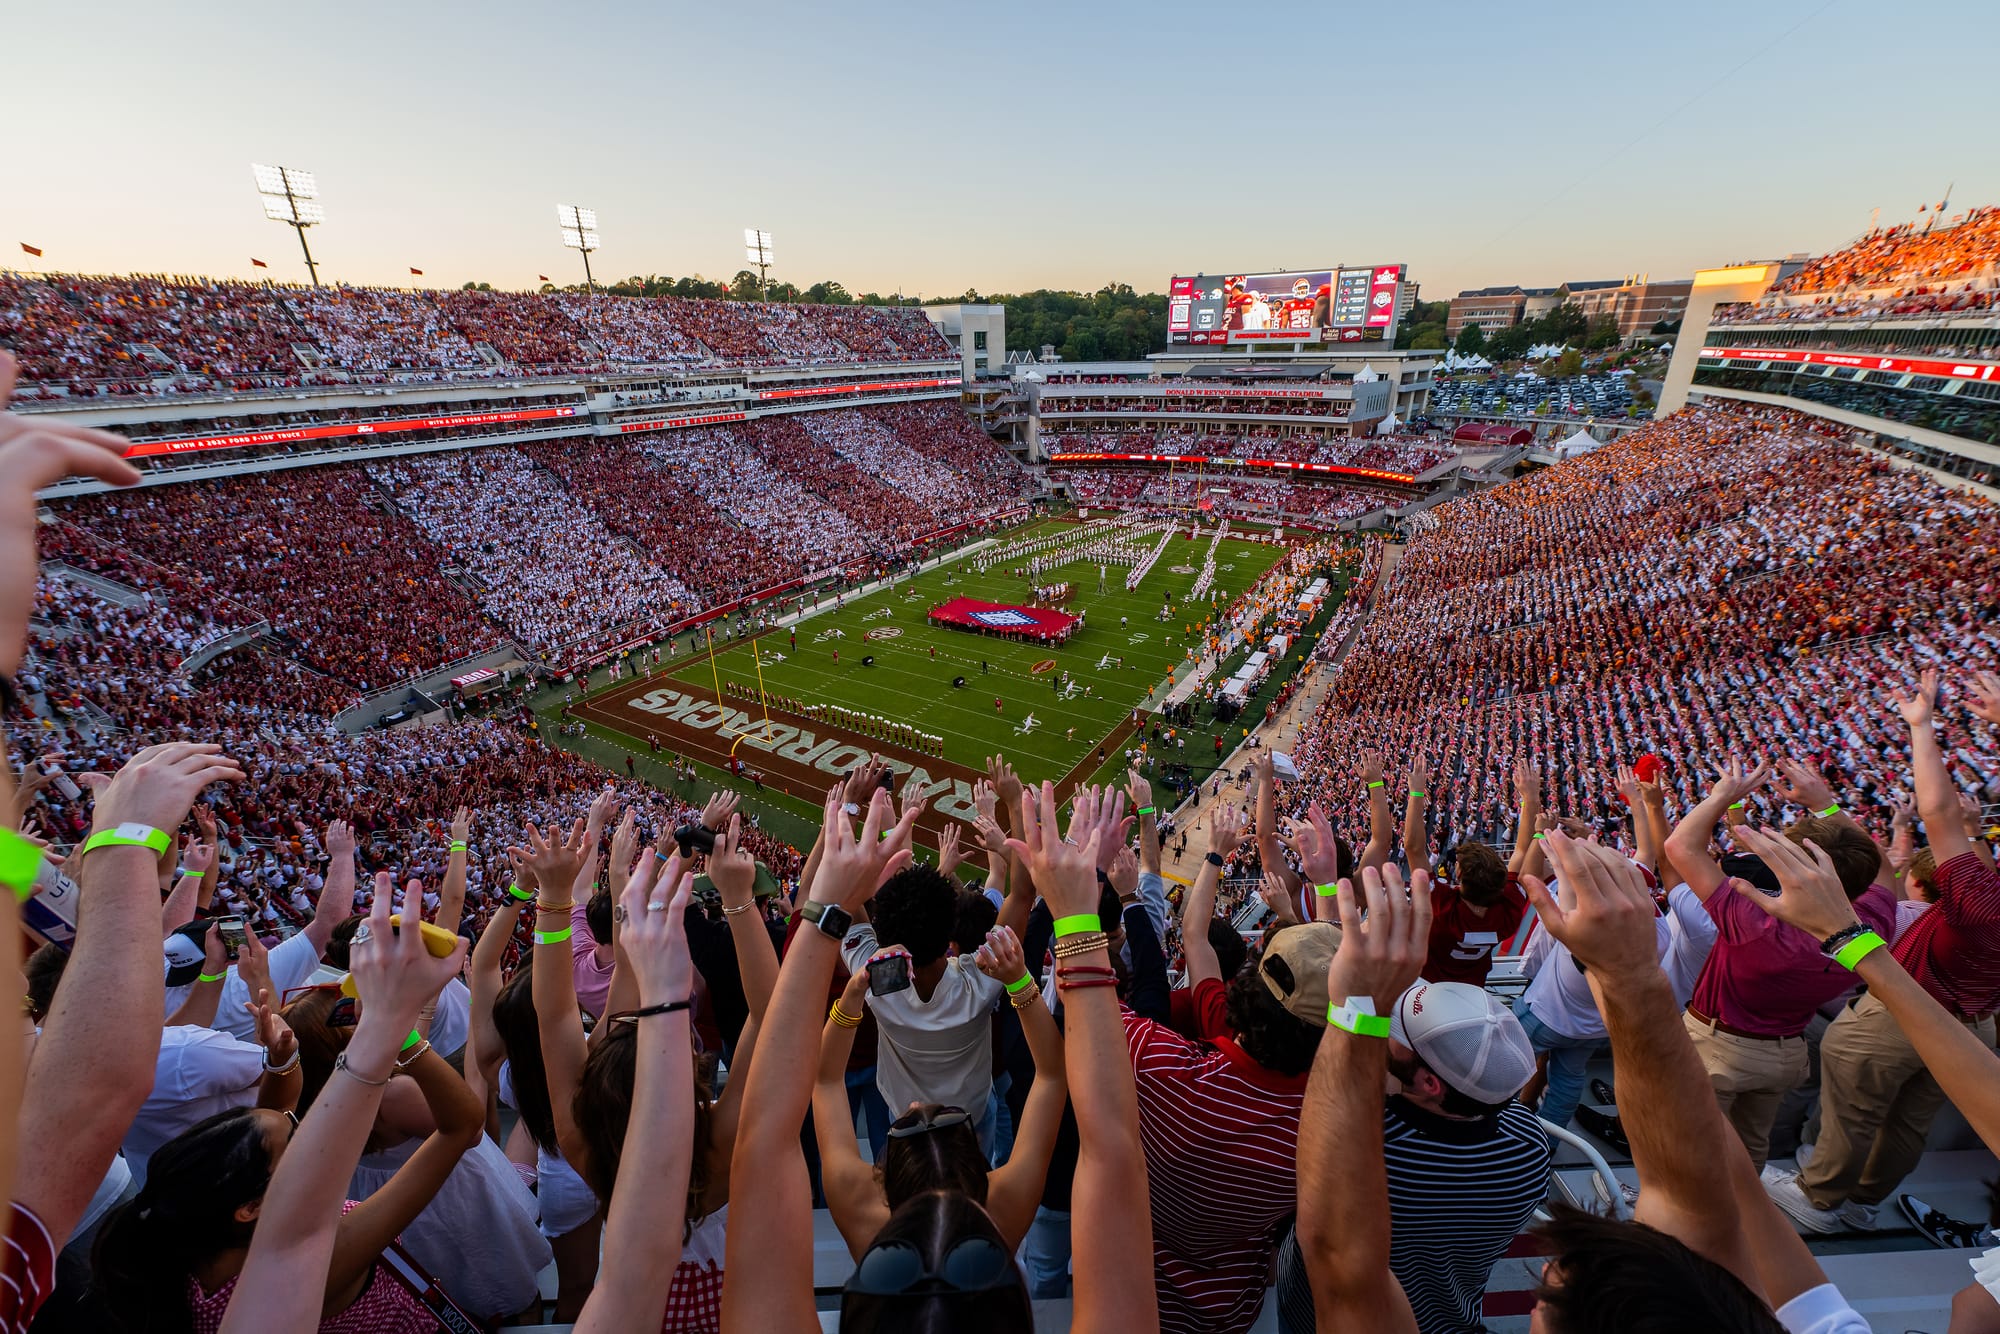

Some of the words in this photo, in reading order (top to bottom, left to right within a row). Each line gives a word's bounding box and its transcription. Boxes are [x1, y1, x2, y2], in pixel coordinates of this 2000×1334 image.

[1243, 390, 1288, 398] RAZORBACK
[621, 423, 650, 432] HOME
[653, 421, 665, 429] OF
[668, 419, 687, 427] THE
[689, 413, 745, 424] RAZORBACKS
[172, 441, 195, 449] WITH
[207, 438, 227, 446] 2024
[228, 435, 250, 444] FORD
[277, 430, 300, 440] TRUCK
[1450, 931, 1498, 960] 5
